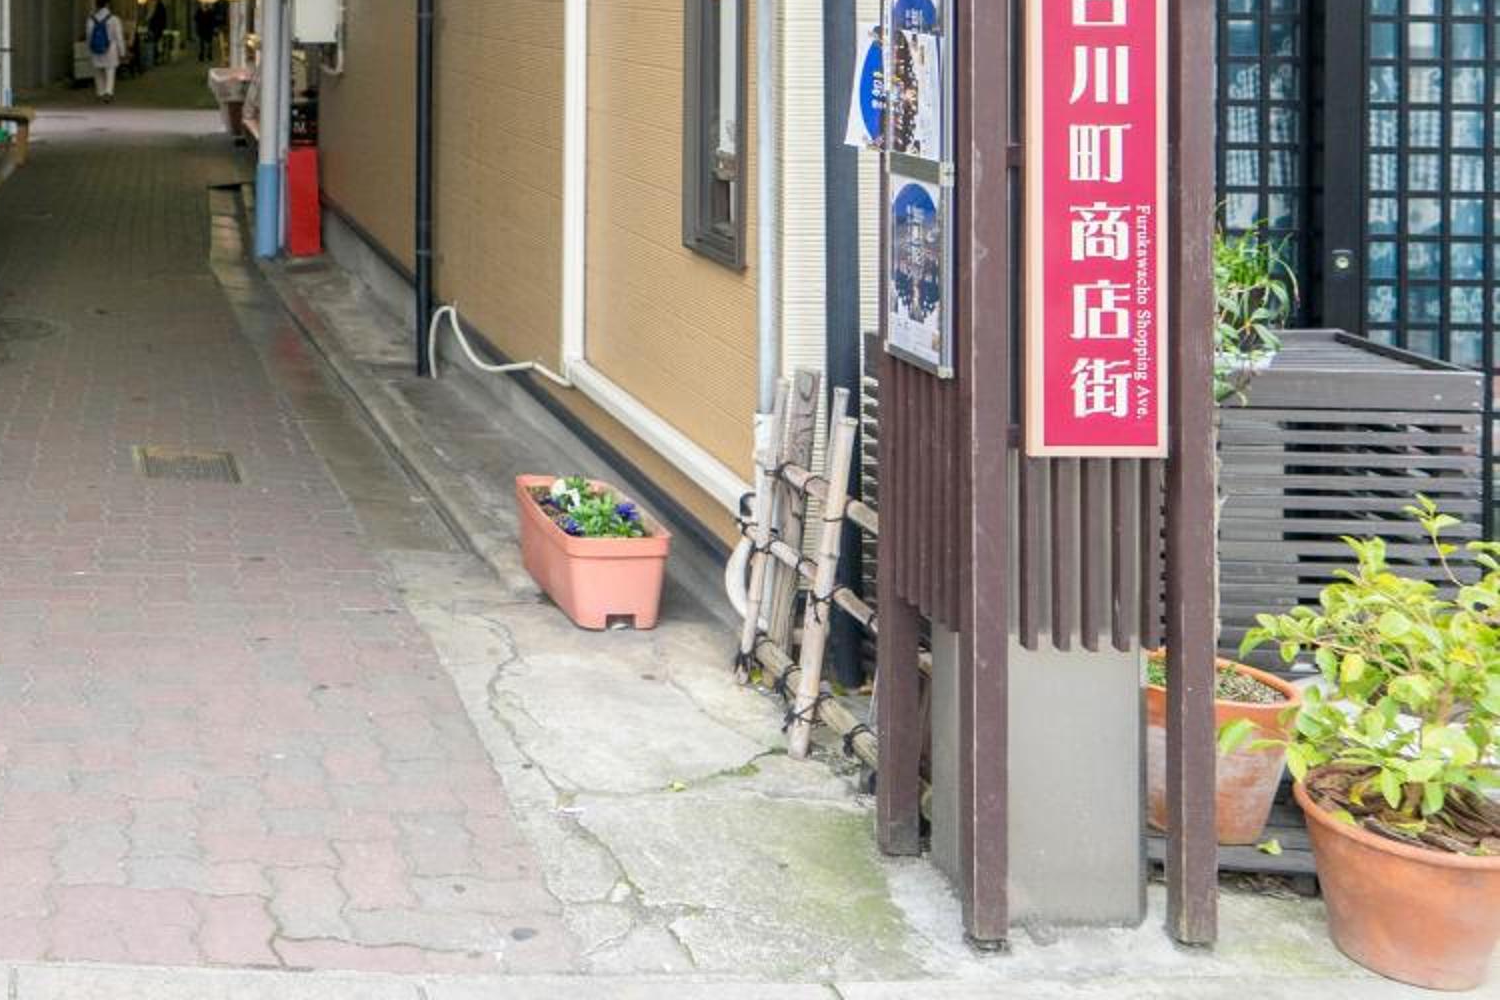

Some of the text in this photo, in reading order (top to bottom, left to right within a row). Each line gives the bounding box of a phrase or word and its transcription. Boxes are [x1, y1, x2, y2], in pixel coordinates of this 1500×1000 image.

[1134, 205, 1151, 420] Furukawacho Shopping Ave.
